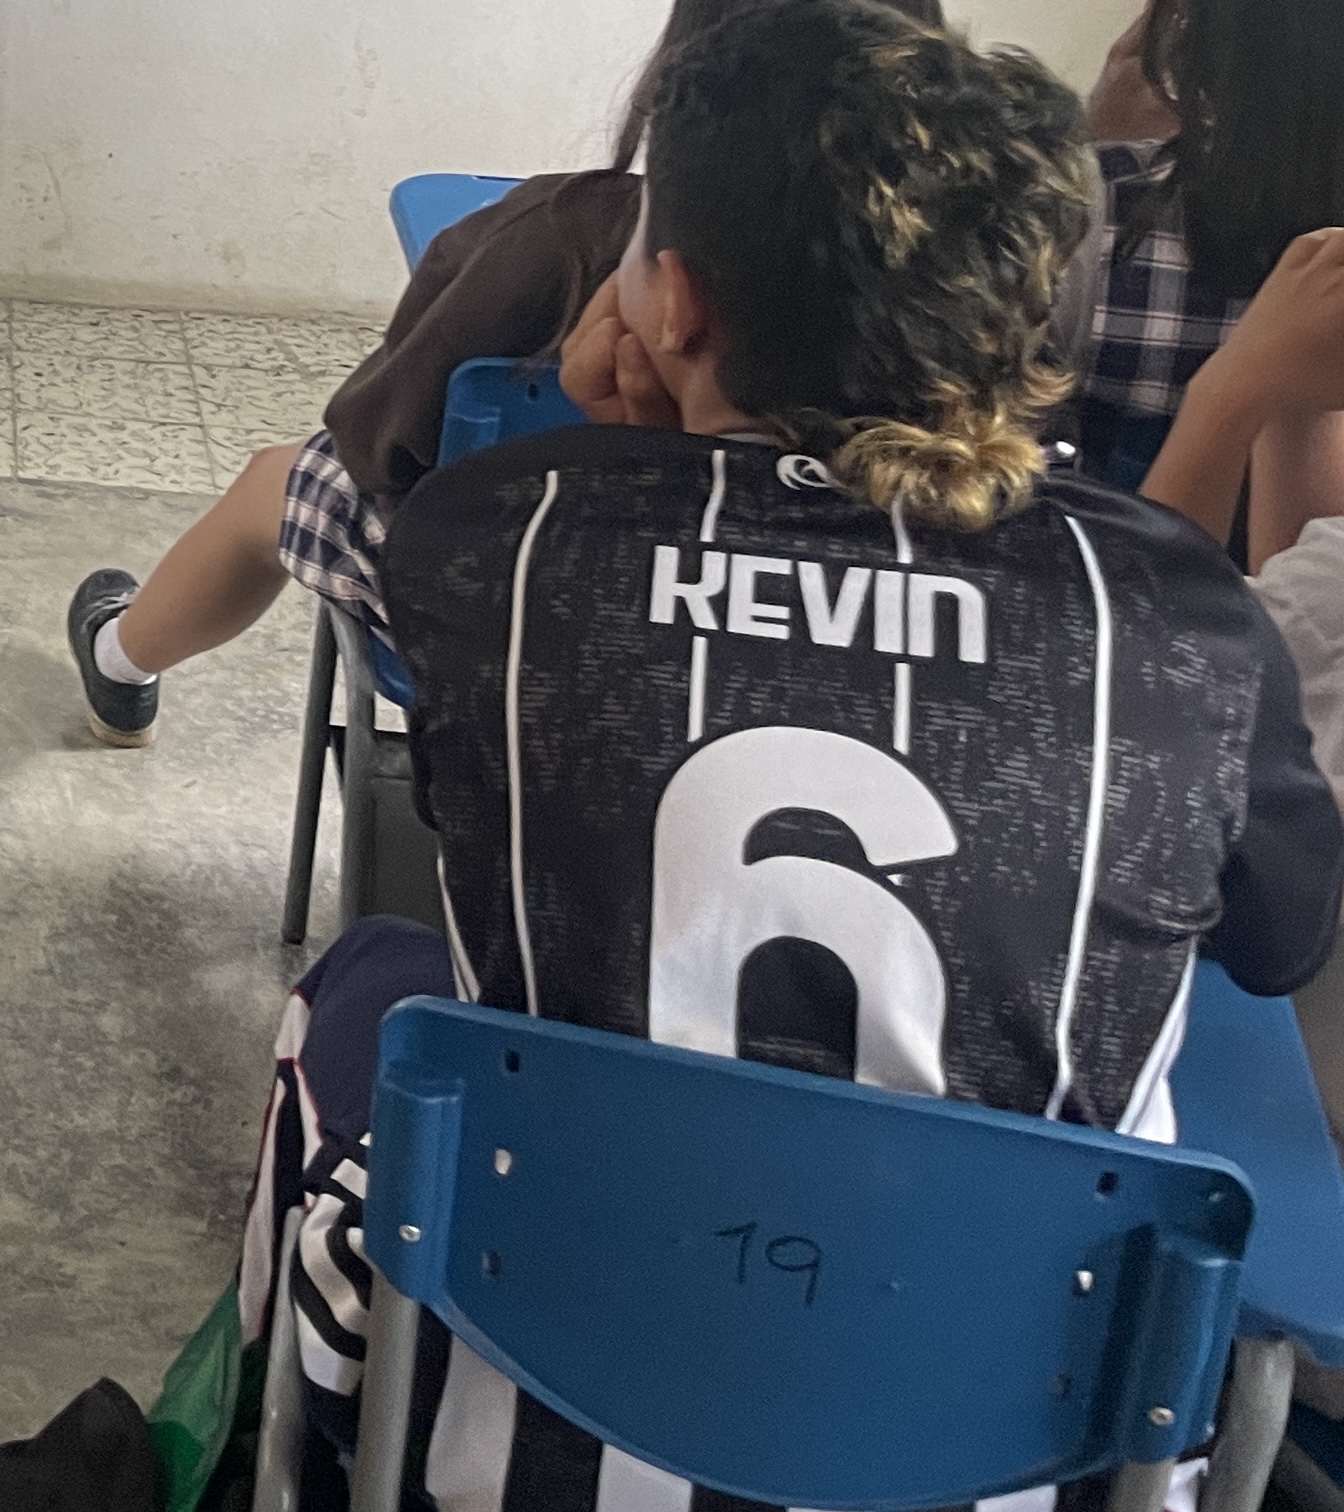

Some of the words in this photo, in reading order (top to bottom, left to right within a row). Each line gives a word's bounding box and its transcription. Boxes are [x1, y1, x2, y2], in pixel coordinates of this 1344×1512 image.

[649, 544, 987, 664] KEVIN
[649, 725, 960, 1097] 6
[712, 1220, 823, 1307] 19
